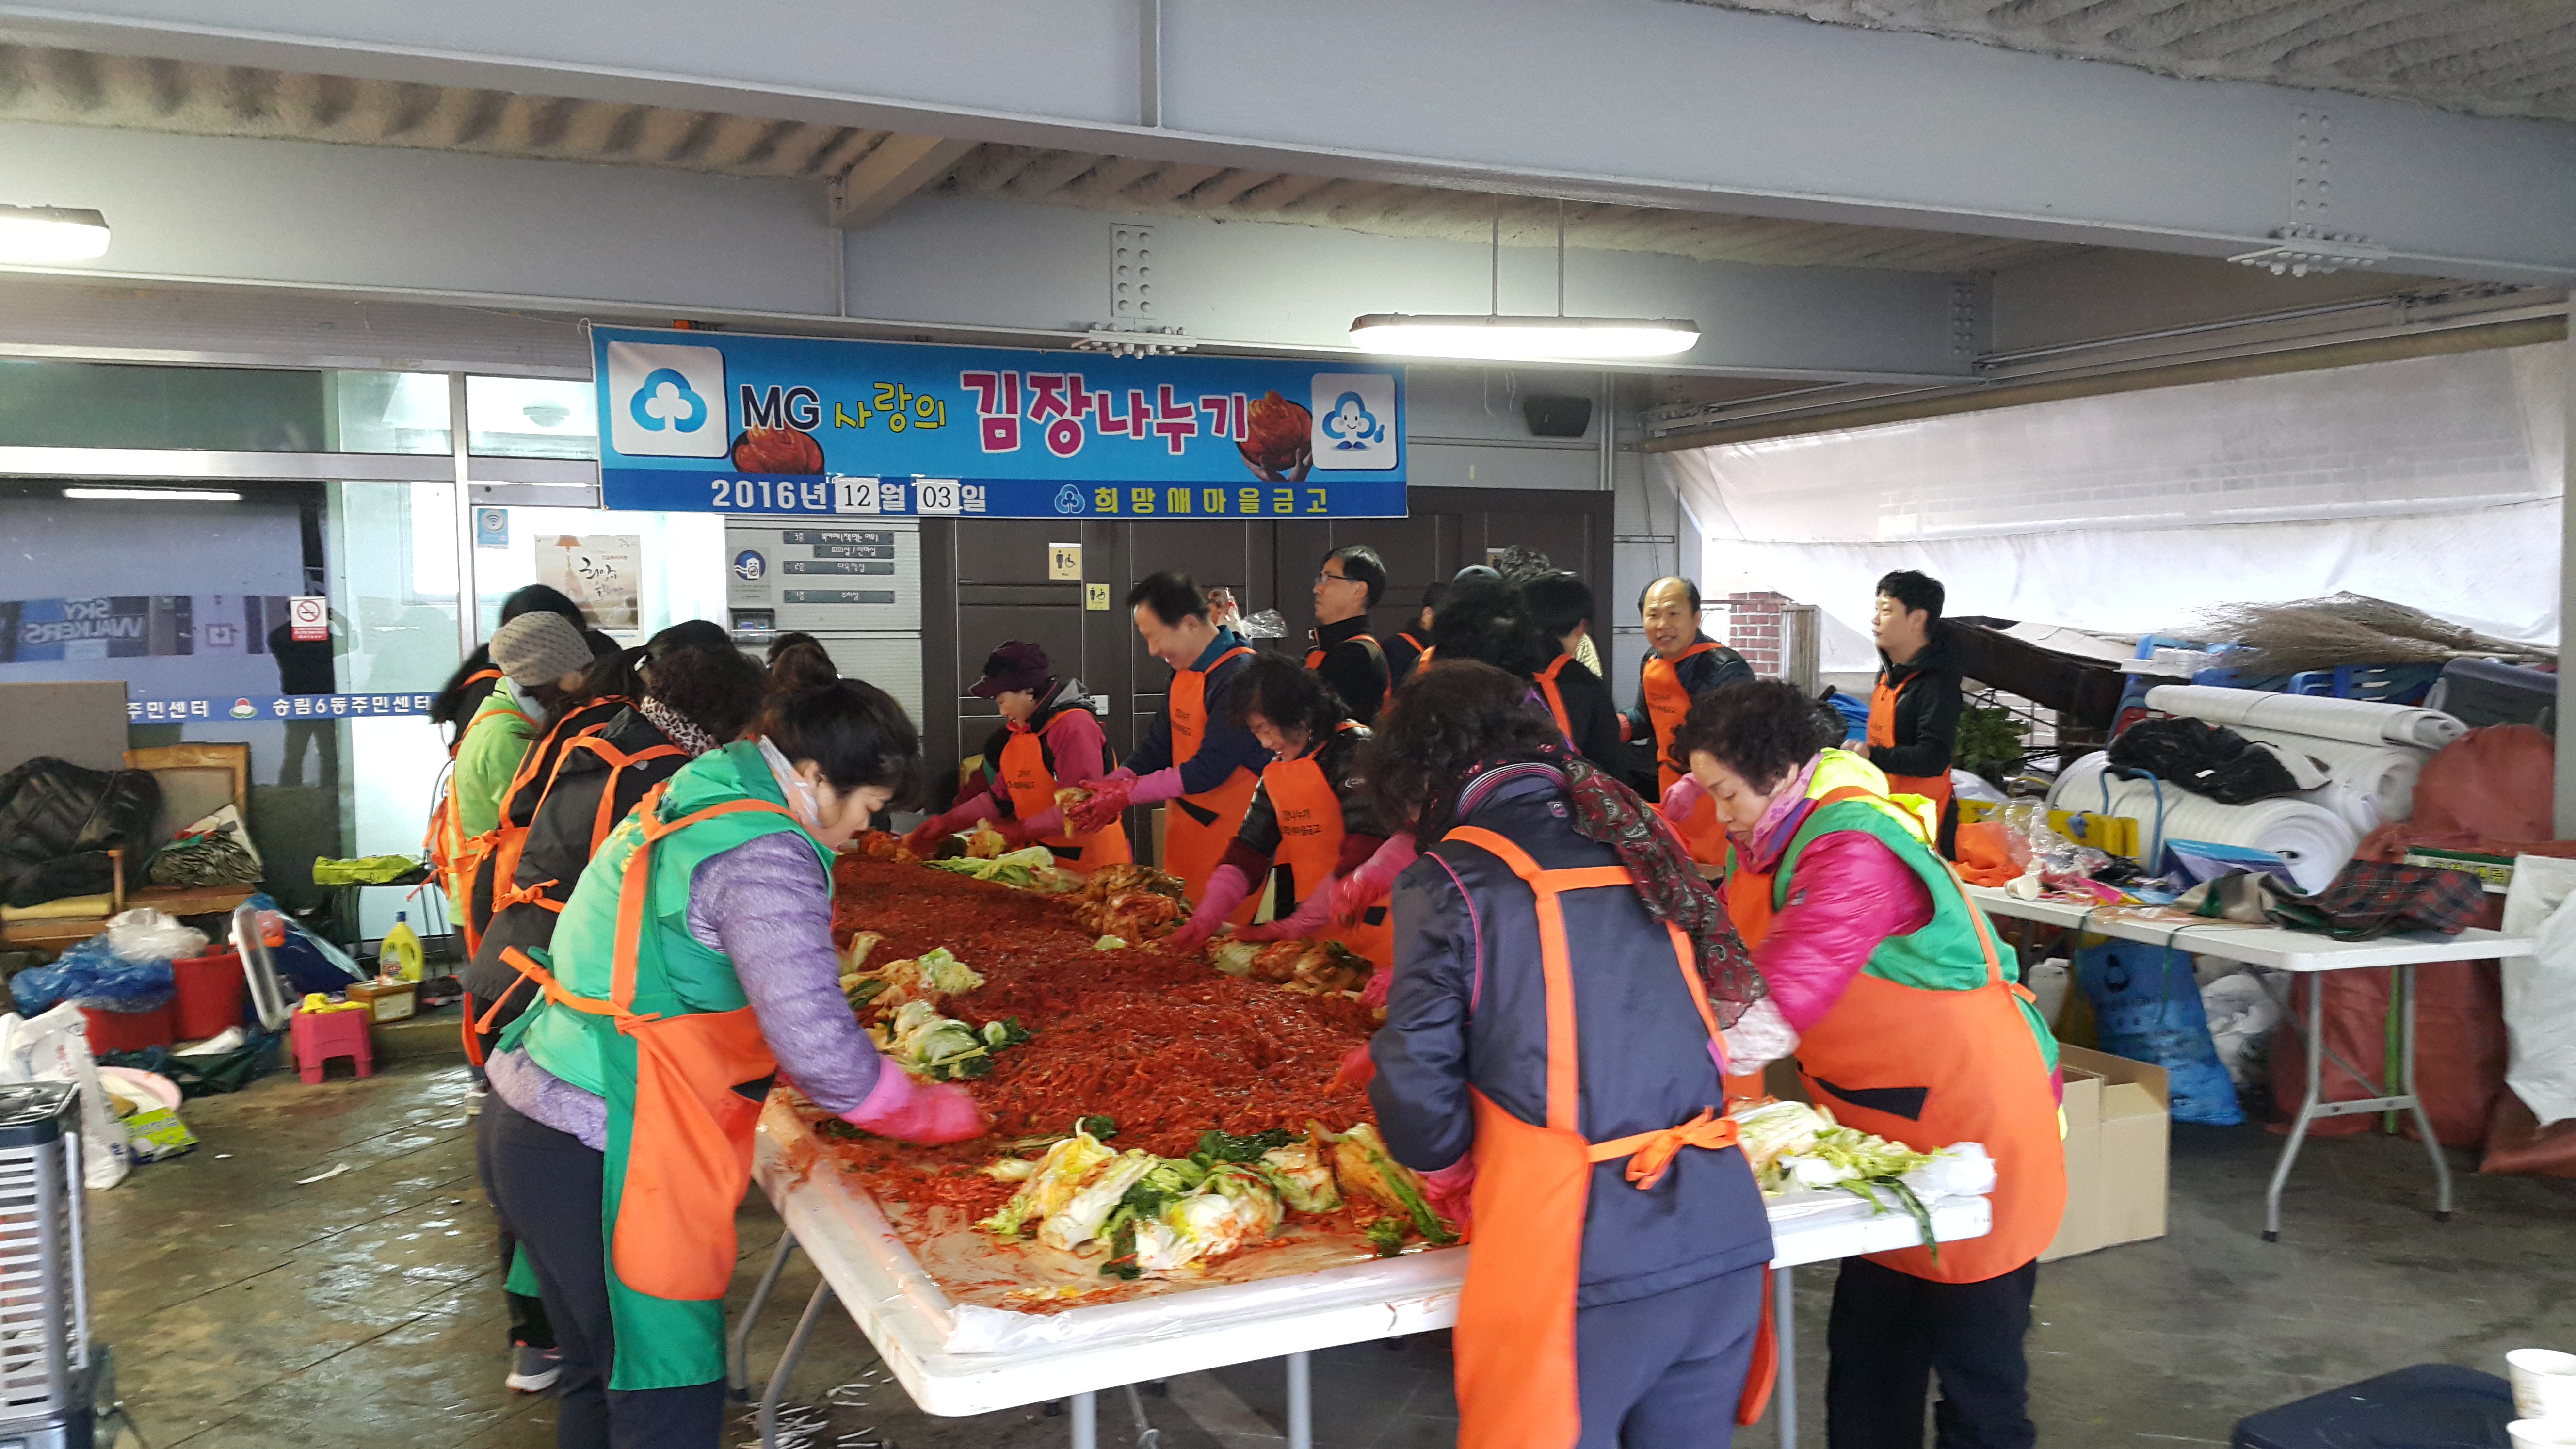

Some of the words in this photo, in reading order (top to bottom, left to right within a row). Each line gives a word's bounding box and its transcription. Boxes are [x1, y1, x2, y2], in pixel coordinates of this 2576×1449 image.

[740, 384, 820, 431] MG
[834, 381, 946, 433] 사랑의
[960, 370, 1249, 458] 김장나누기
[711, 479, 827, 510] 2016년
[1095, 487, 1328, 514] 희망새마을금고
